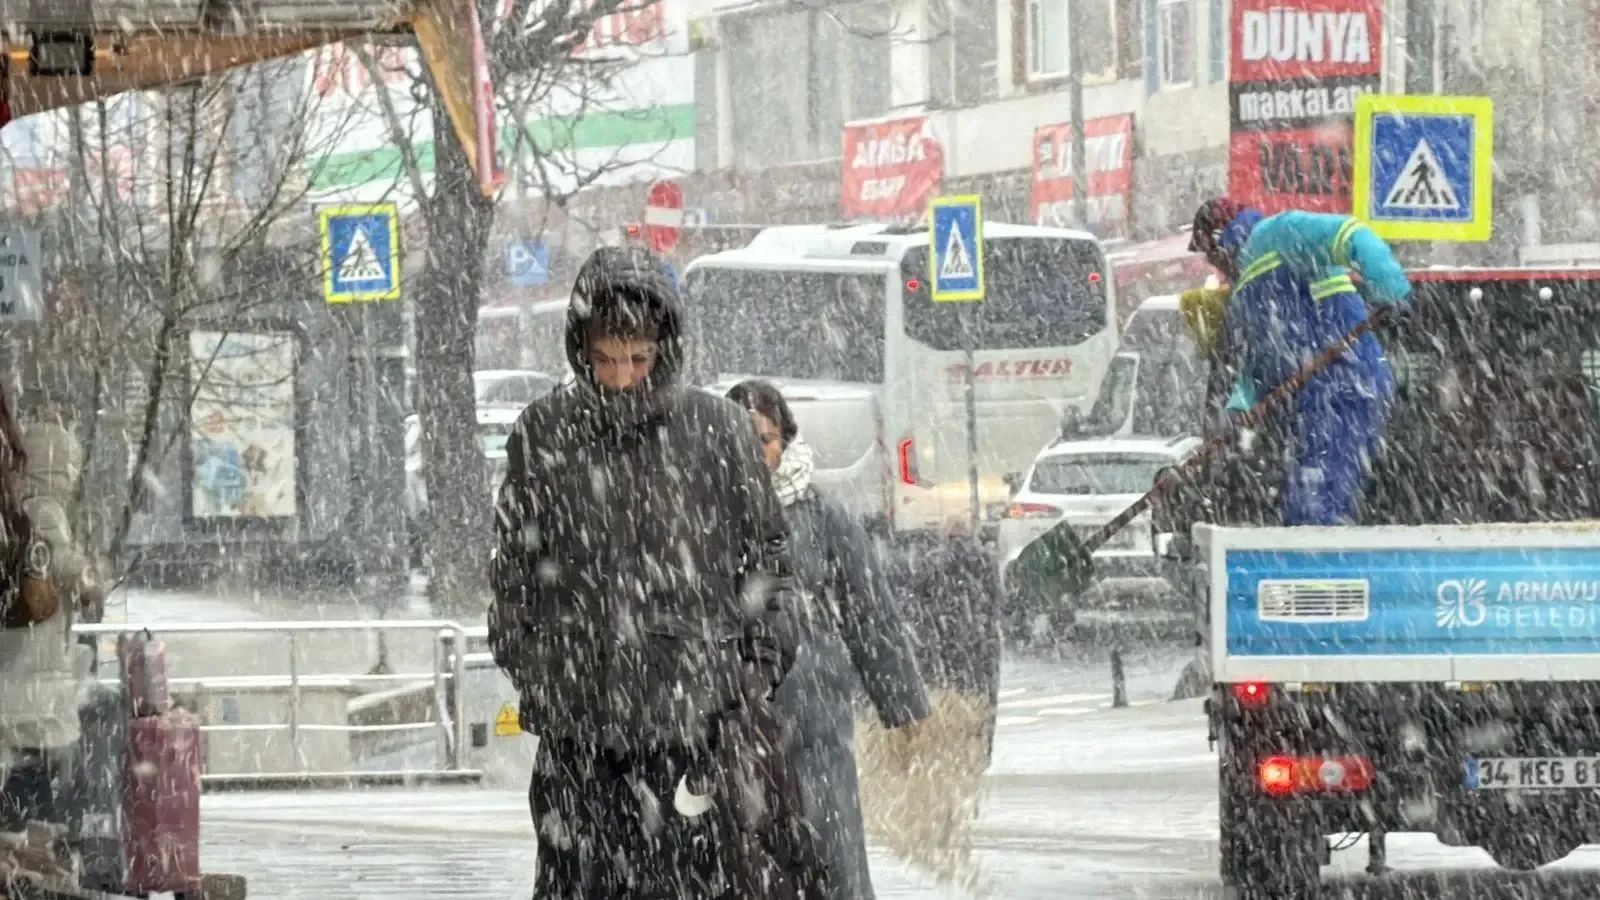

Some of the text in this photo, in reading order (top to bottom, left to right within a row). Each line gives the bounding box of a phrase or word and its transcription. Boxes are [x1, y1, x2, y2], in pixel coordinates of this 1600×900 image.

[1241, 6, 1371, 64] DÜNYA
[511, 245, 529, 273] P
[1480, 761, 1509, 786] 34
[1520, 761, 1564, 786] MEG
